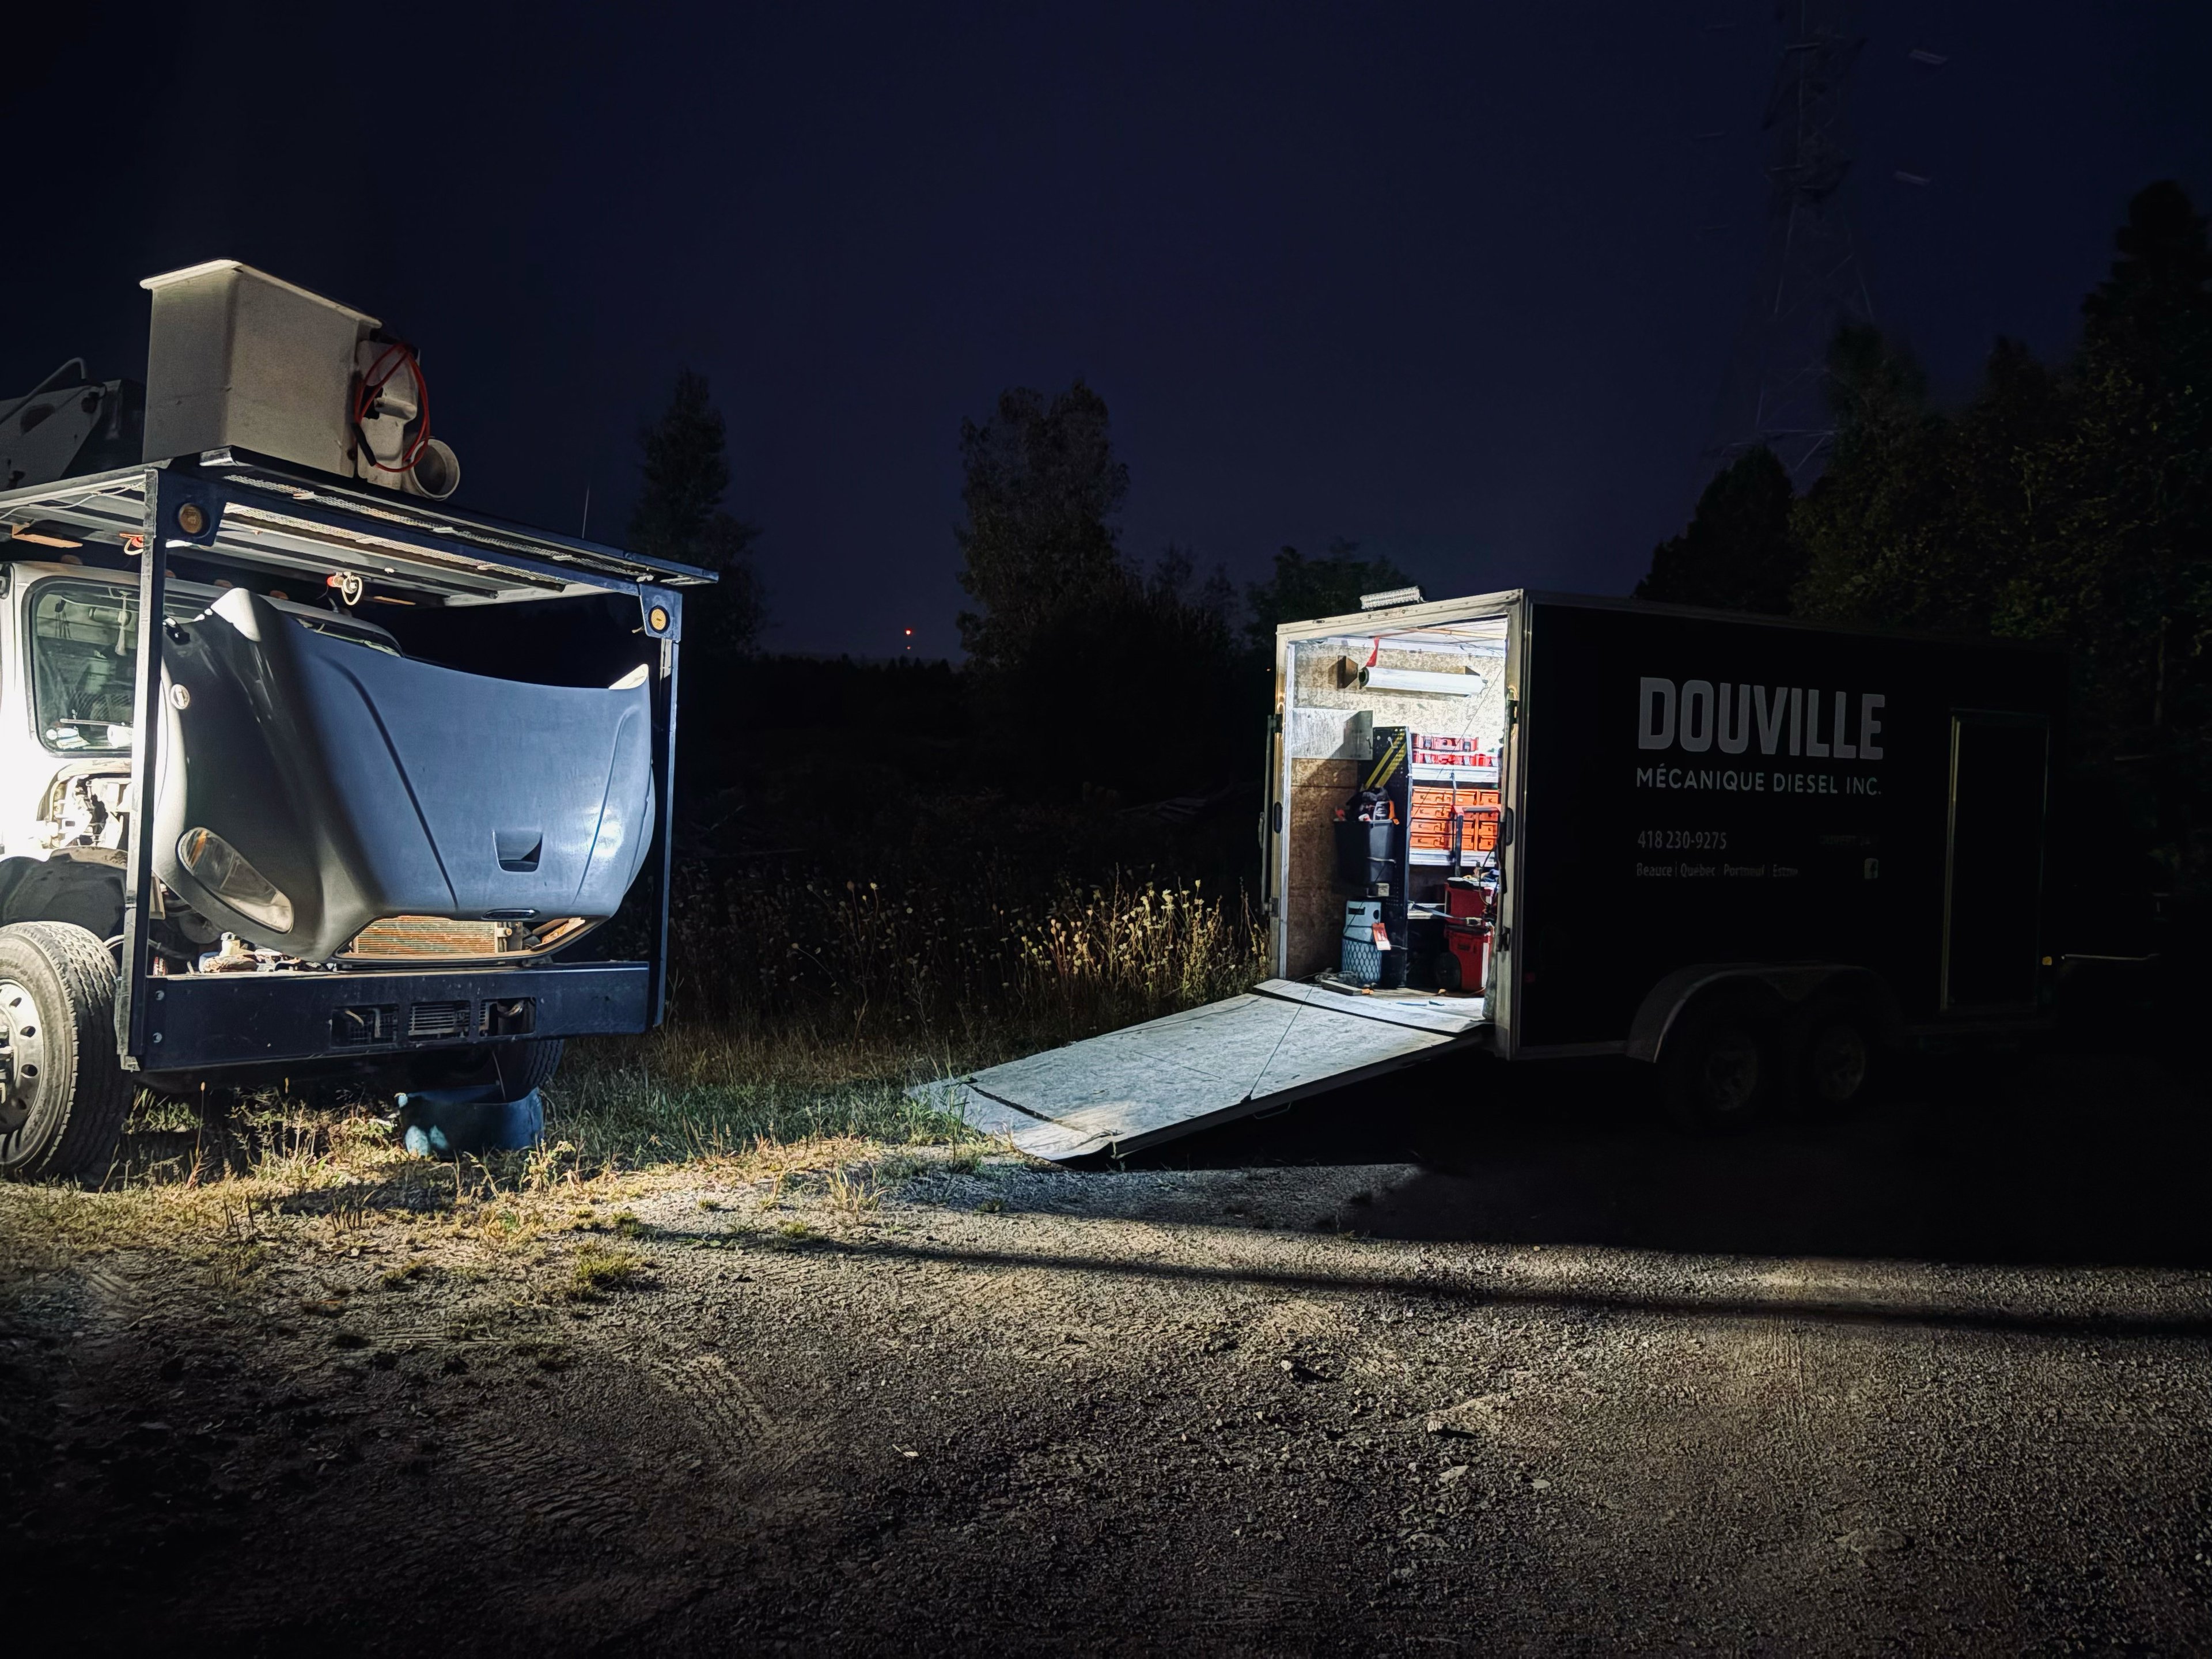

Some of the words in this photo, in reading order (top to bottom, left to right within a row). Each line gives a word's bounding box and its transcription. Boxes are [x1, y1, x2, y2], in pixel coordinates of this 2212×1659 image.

[1638, 676, 1885, 760] DOUVILLE
[1636, 763, 1765, 792] MÉCANIQUE
[1773, 772, 1838, 794] DIESEL
[1846, 776, 1882, 796] INC.
[1637, 830, 1664, 849] 418
[1665, 830, 1728, 850] 230-9275
[1636, 862, 1673, 877] Beauce
[1680, 862, 1716, 878] Québec
